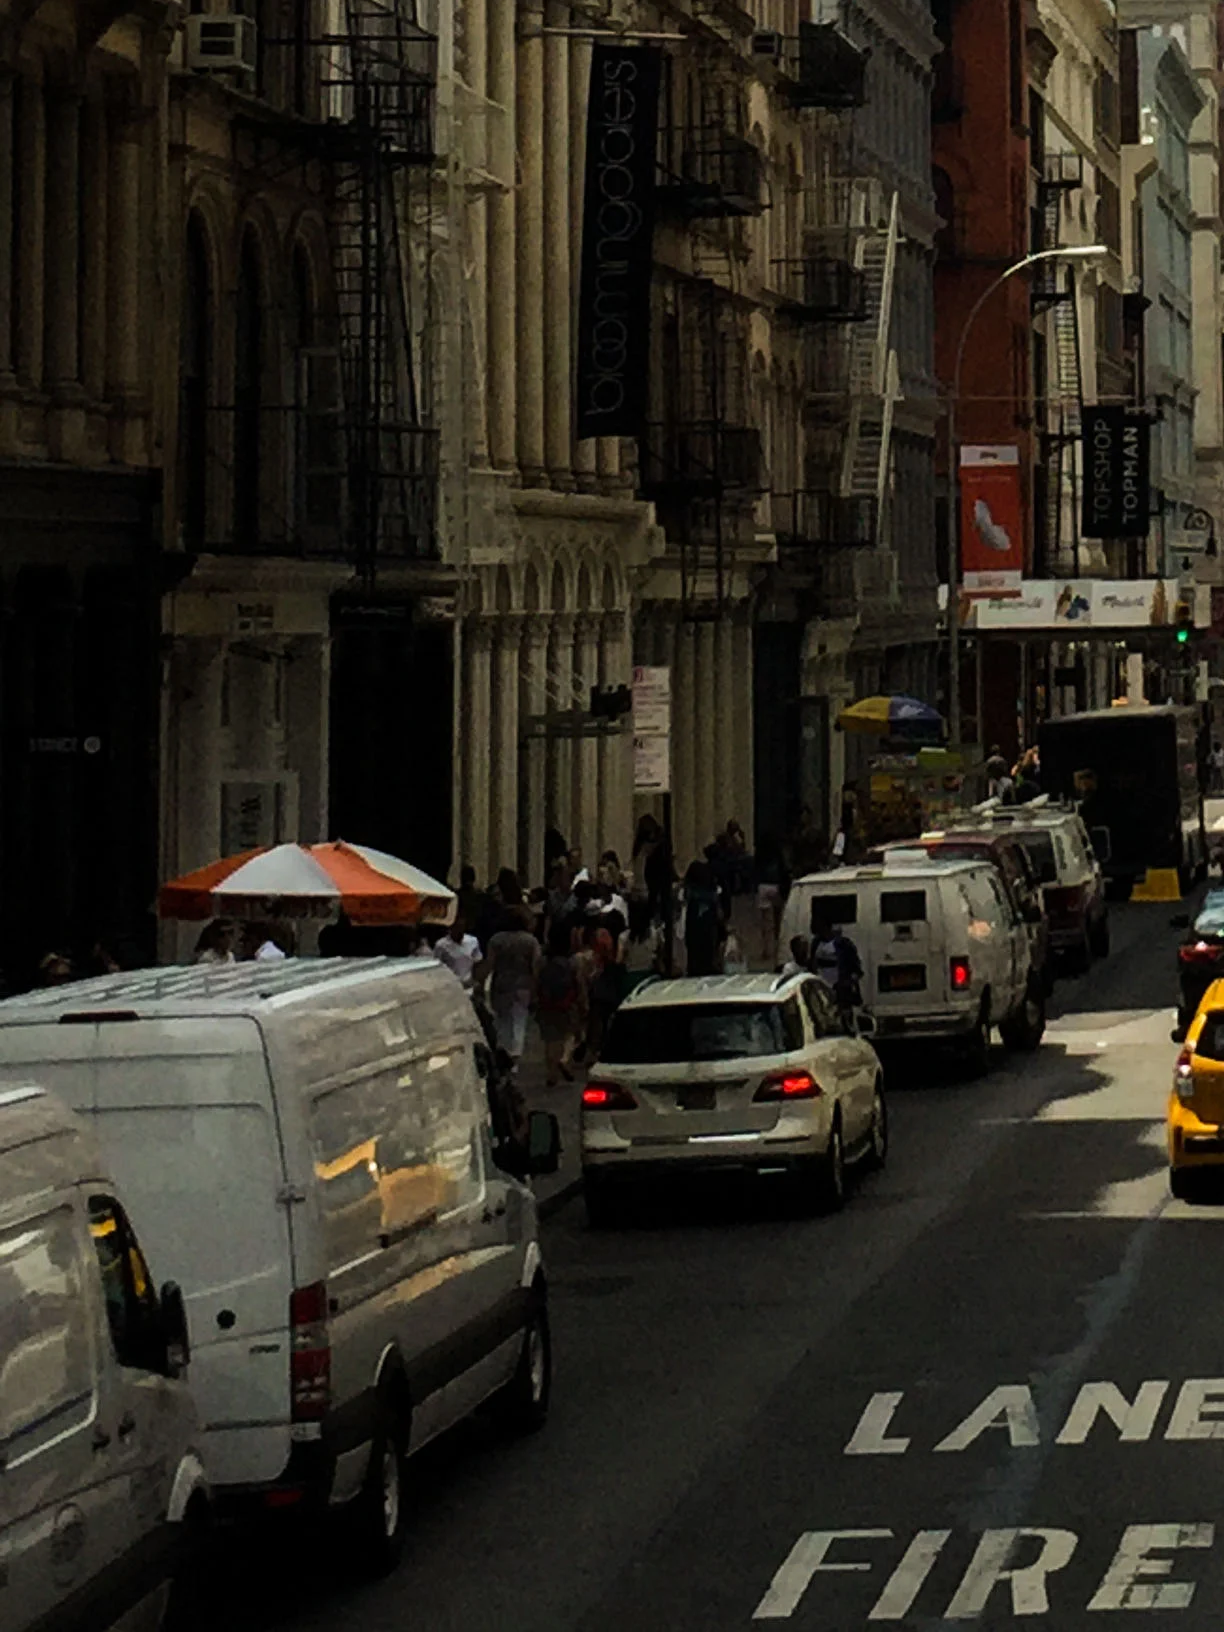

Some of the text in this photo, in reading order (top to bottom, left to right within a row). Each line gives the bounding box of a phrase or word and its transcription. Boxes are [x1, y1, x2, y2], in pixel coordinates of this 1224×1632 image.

[1093, 418, 1112, 525] TOPSHOP
[1122, 426, 1139, 525] TOPMAN
[751, 1522, 1216, 1620] FIRE
